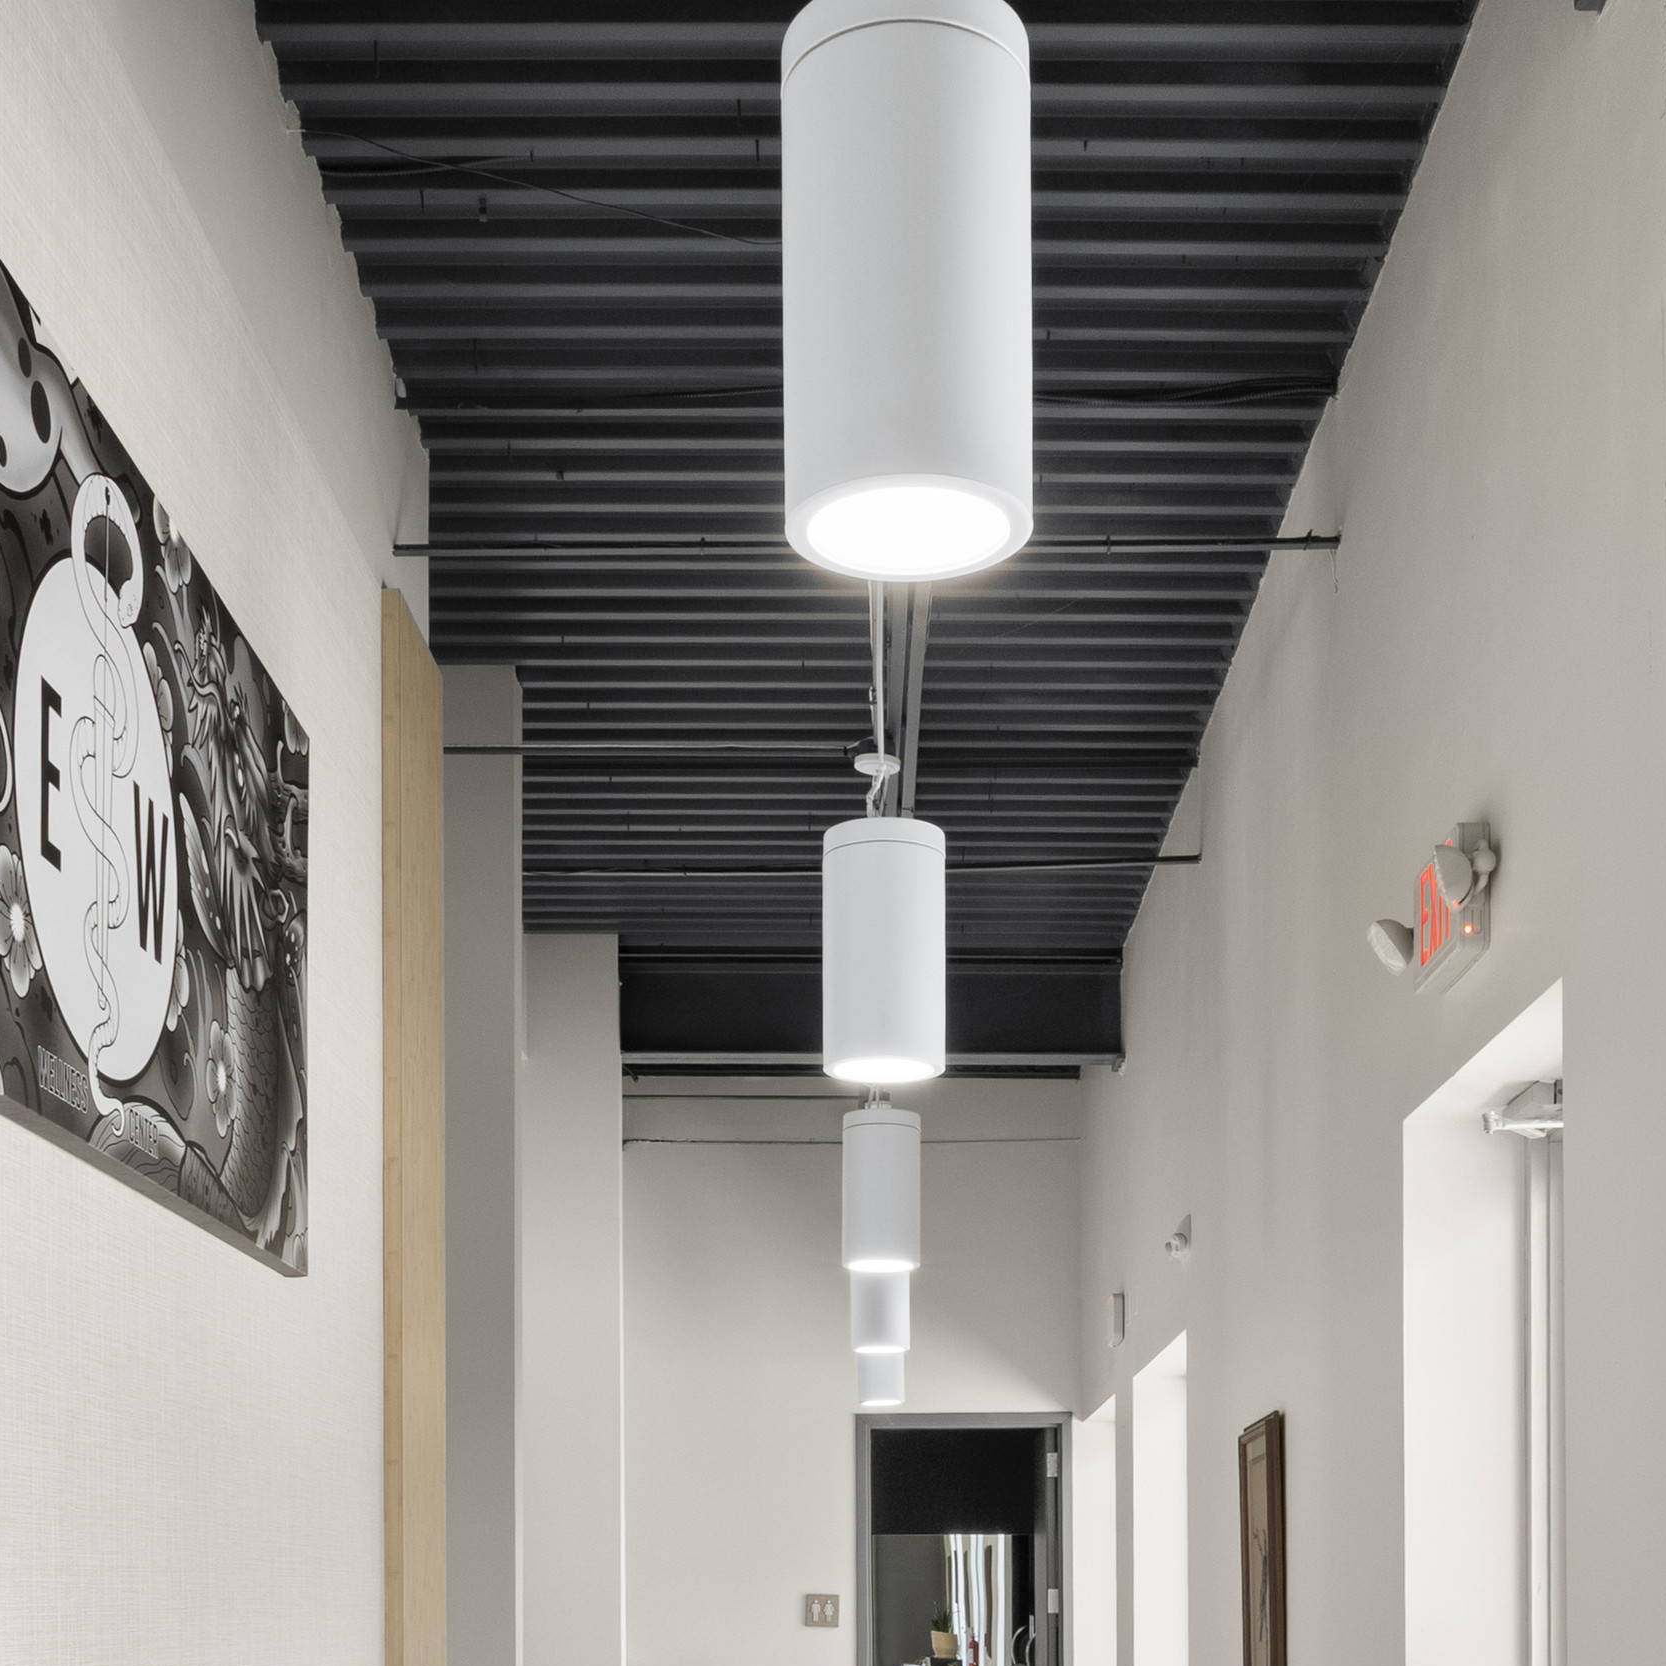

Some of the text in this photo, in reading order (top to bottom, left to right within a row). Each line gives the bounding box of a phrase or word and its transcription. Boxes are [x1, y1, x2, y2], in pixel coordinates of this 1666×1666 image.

[41, 675, 169, 965] E W
[37, 1045, 159, 1159] WELLNESS CENTER
